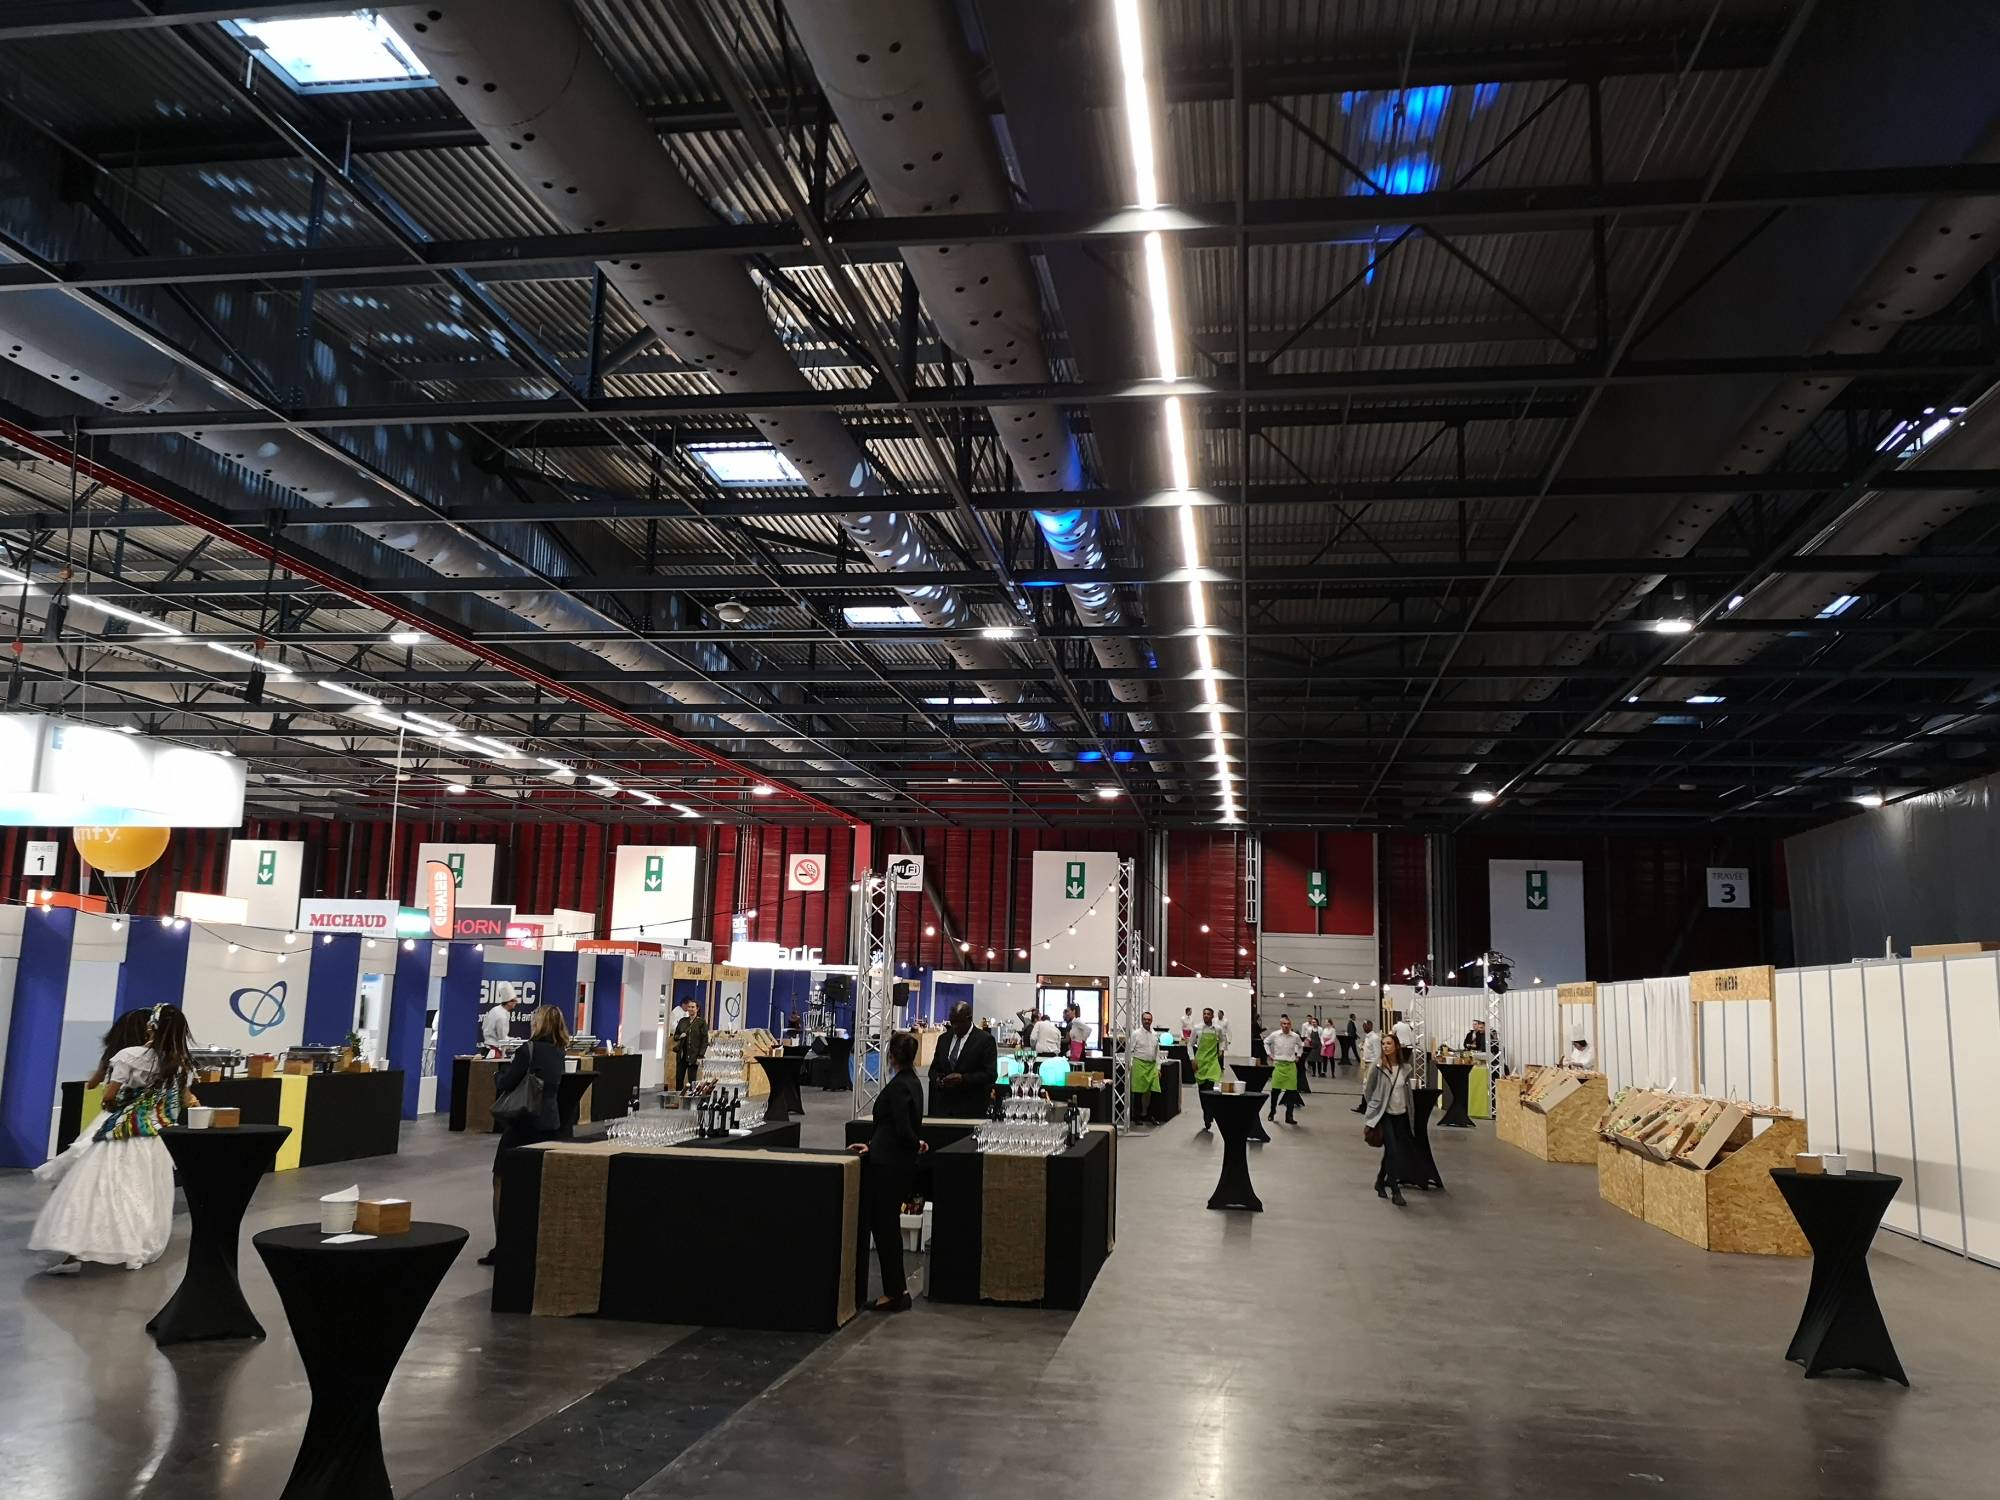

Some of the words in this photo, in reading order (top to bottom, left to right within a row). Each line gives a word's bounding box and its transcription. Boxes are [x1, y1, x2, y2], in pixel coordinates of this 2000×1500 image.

[37, 855, 45, 872] 1
[1721, 884, 1736, 904] 3
[309, 913, 387, 928] MICHAUD
